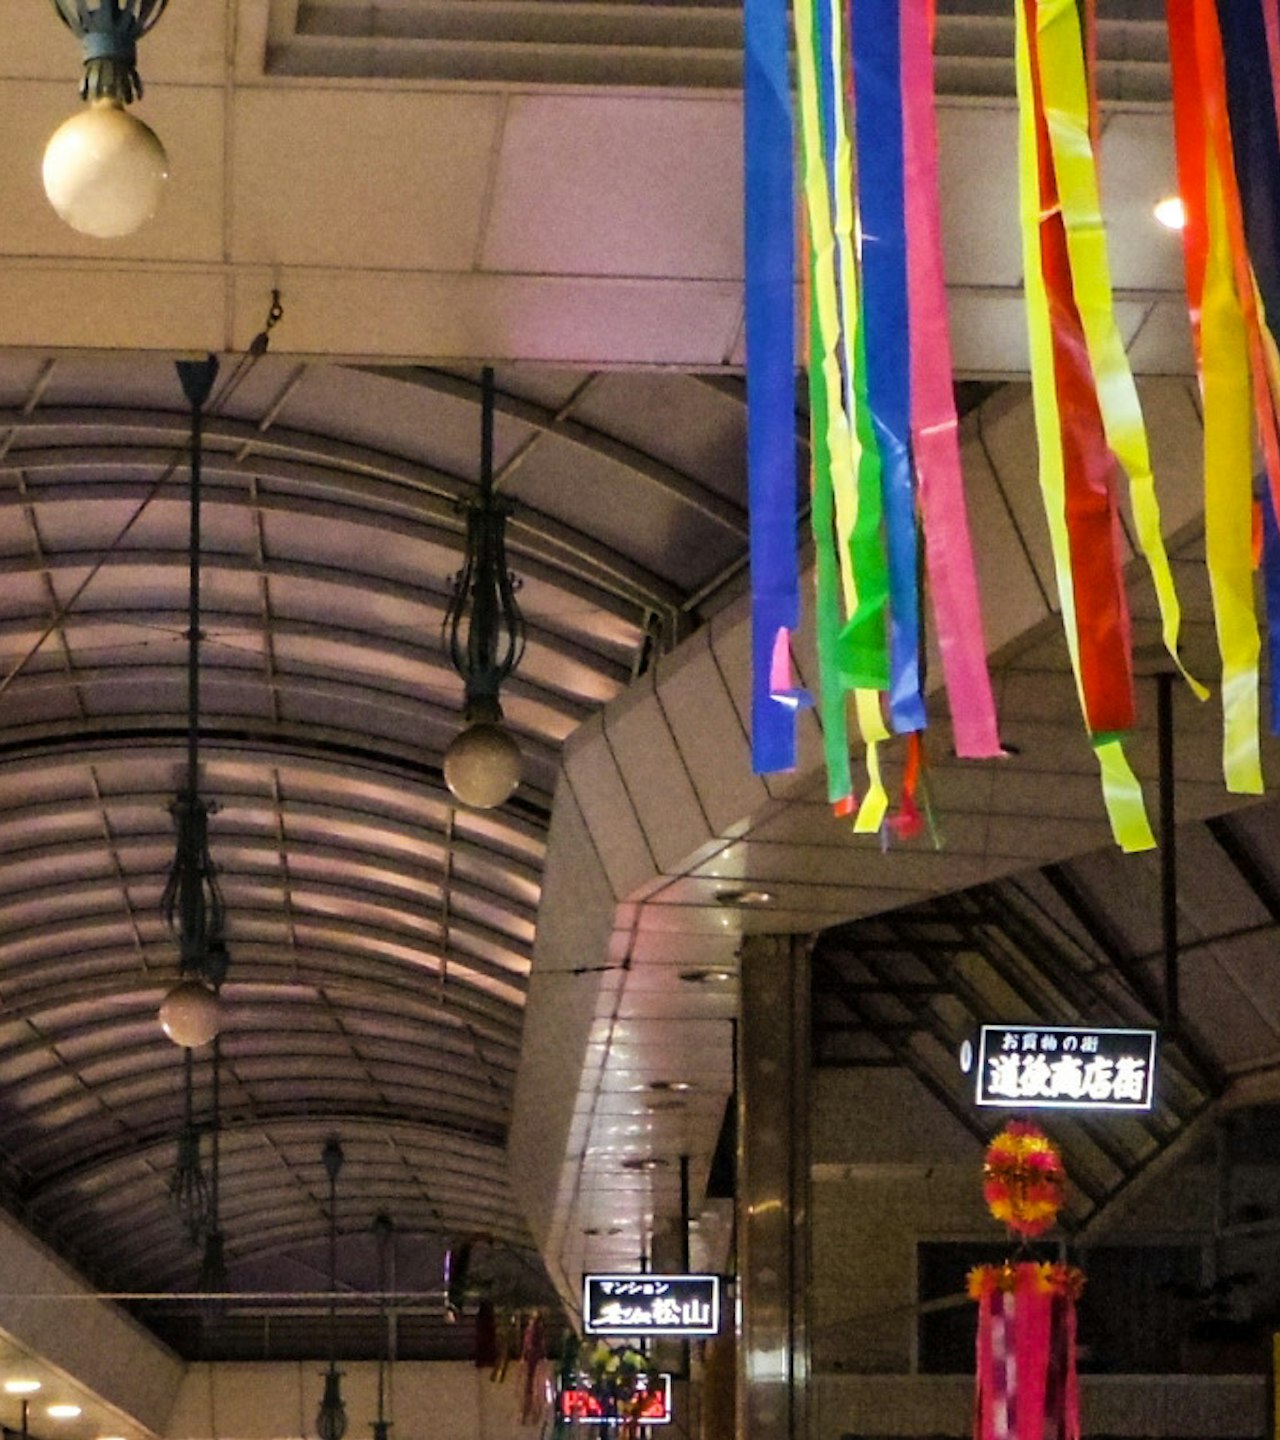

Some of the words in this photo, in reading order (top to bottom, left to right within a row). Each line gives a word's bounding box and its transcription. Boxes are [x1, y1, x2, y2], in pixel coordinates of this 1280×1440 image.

[1001, 1032, 1099, 1053] お買物の街
[988, 1054, 1145, 1100] 道後商店街
[600, 1282, 670, 1295] マンション
